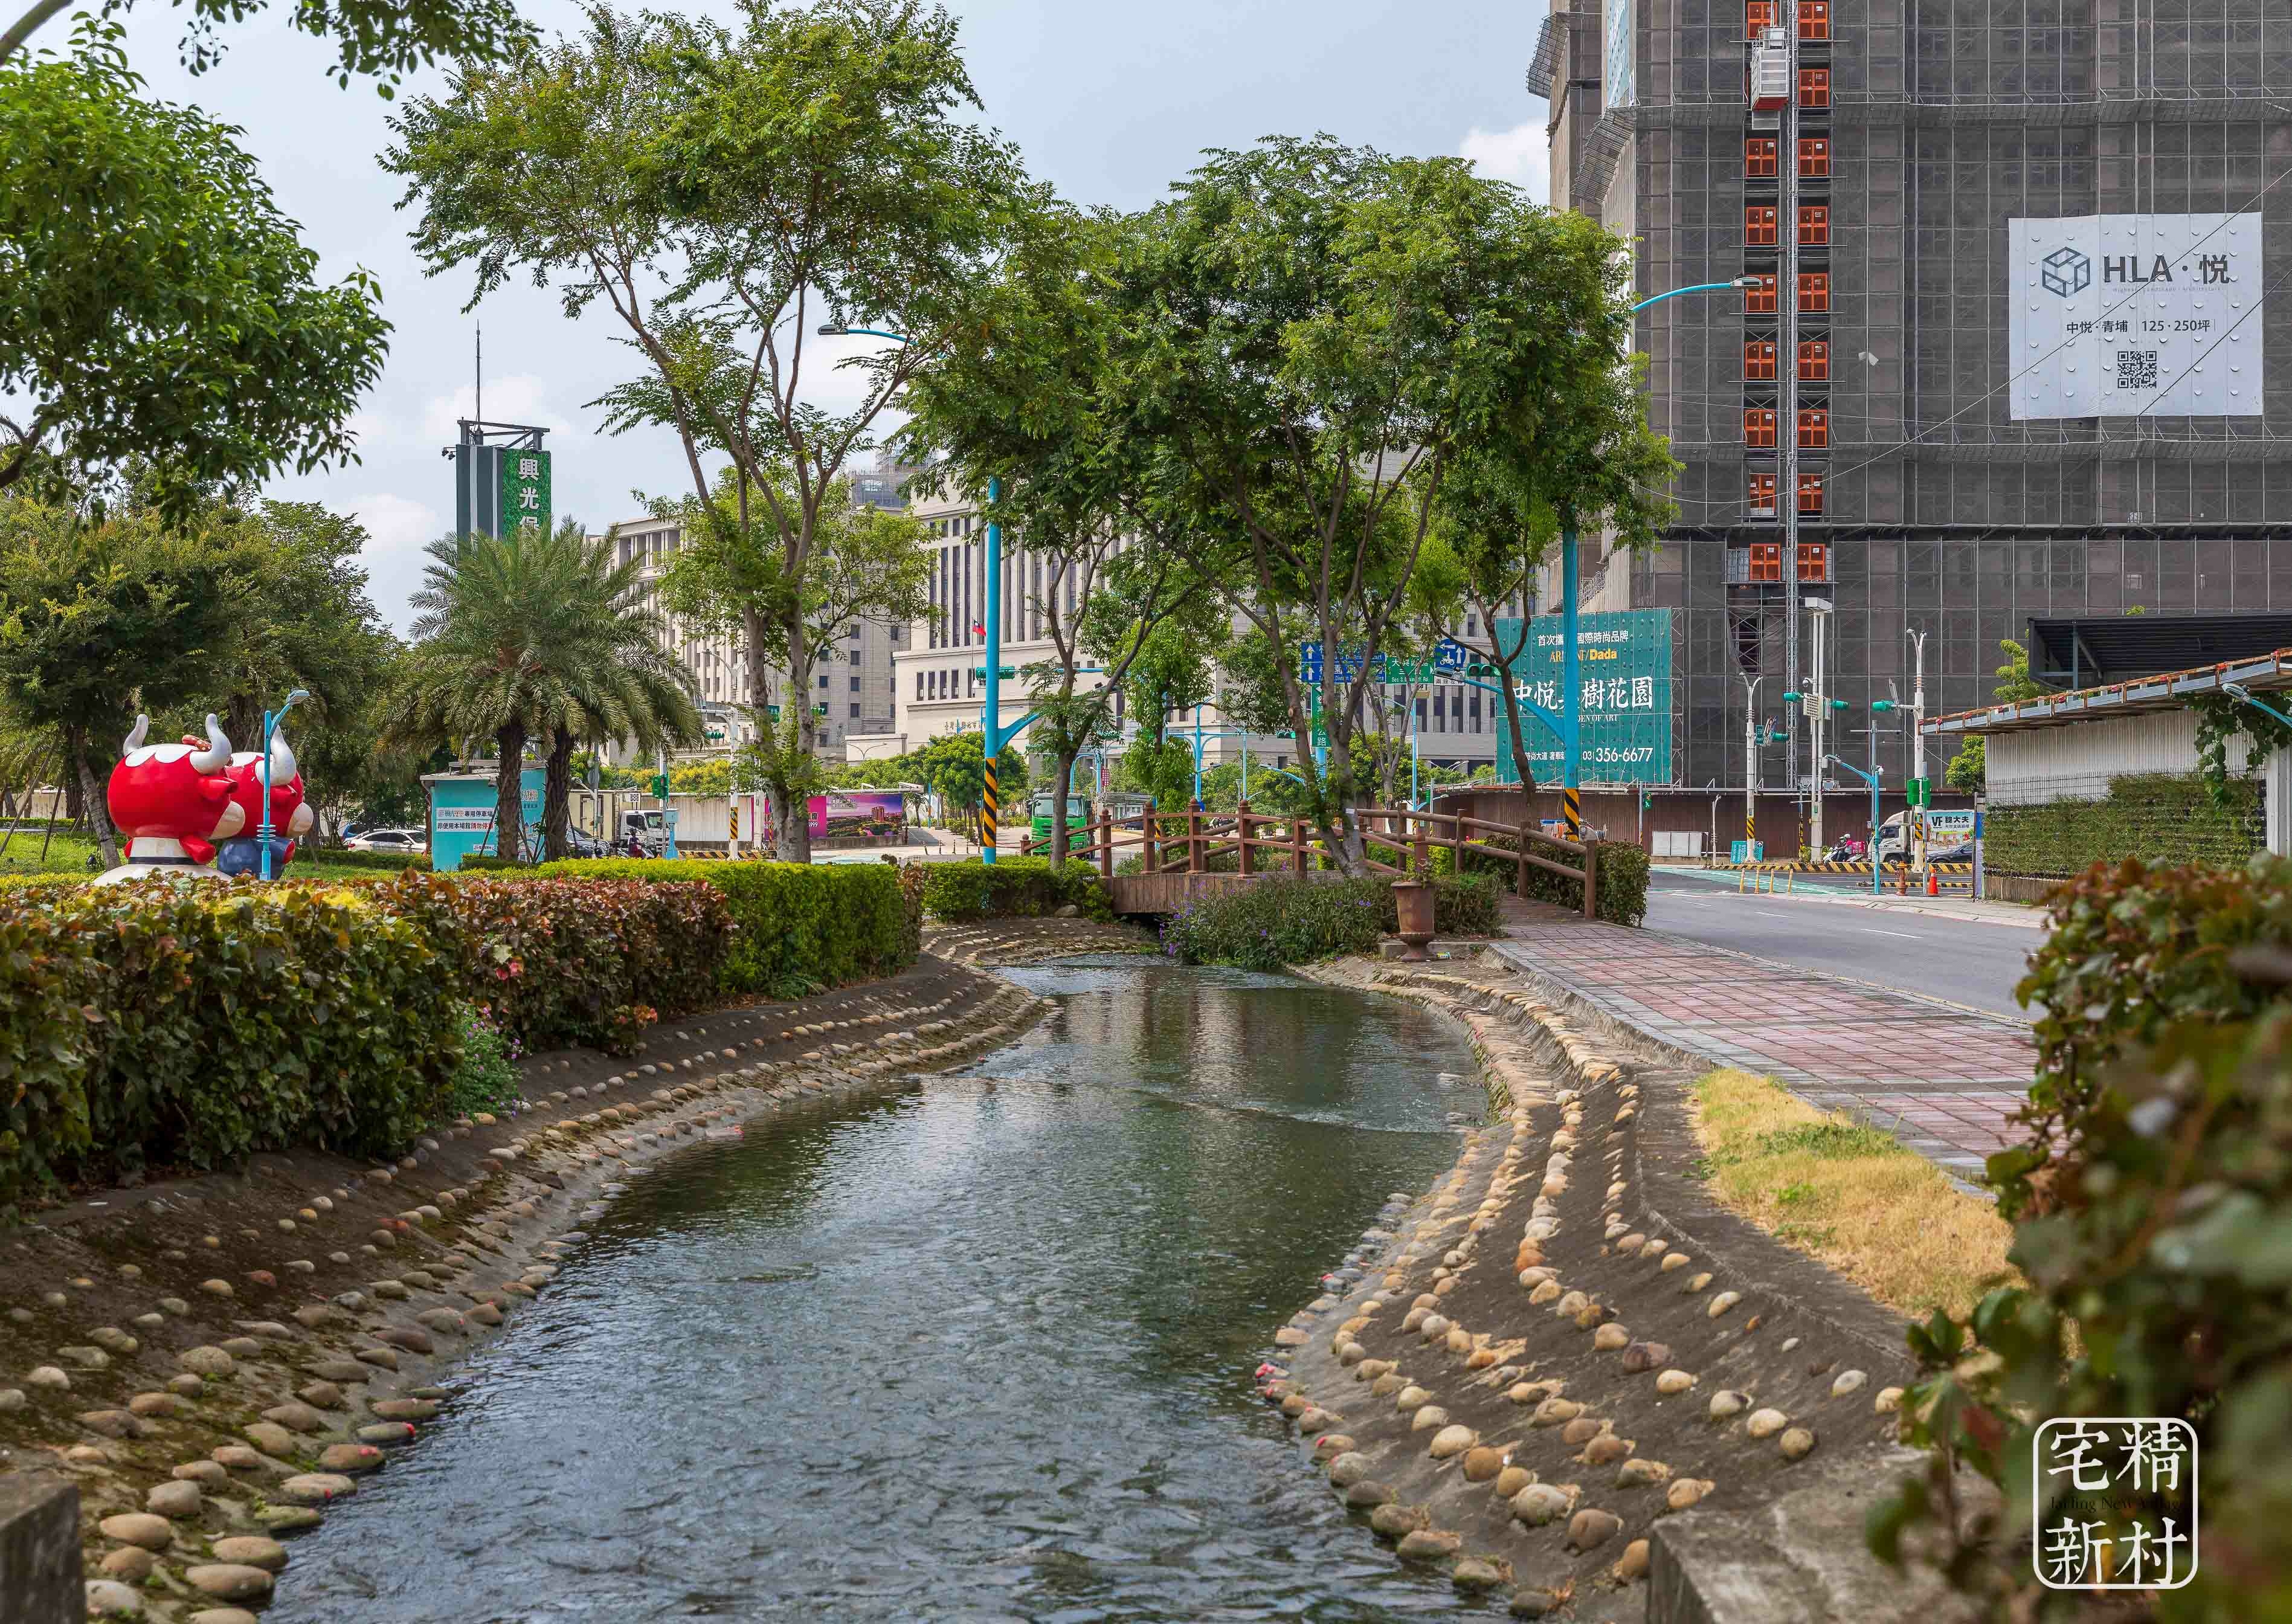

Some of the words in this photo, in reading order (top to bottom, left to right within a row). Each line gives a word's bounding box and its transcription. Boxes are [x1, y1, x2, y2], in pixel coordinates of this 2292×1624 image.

[1513, 676, 1653, 711] 中悦樹花園
[1595, 747, 1653, 762] 356-6677
